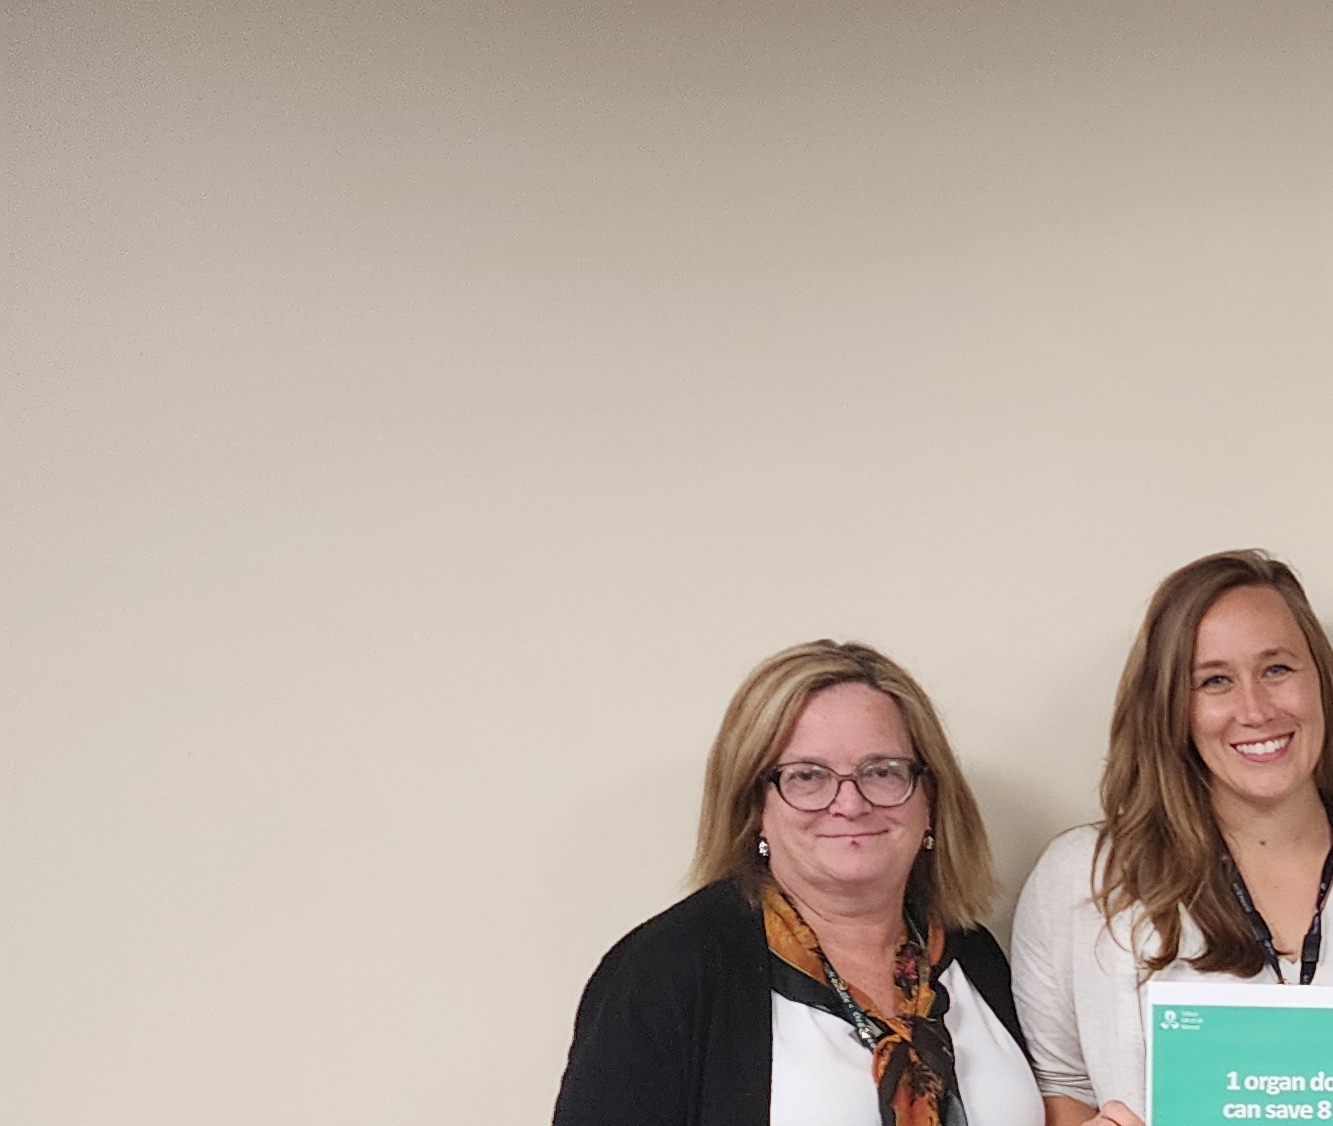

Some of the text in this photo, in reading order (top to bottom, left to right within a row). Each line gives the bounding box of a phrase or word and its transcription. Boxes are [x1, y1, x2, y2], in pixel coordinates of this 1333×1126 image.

[1226, 1071, 1241, 1090] 1
[1244, 1075, 1306, 1096] organ
[1222, 1102, 1262, 1119] can
[1264, 1103, 1314, 1120] save
[1316, 1100, 1332, 1120] 8
